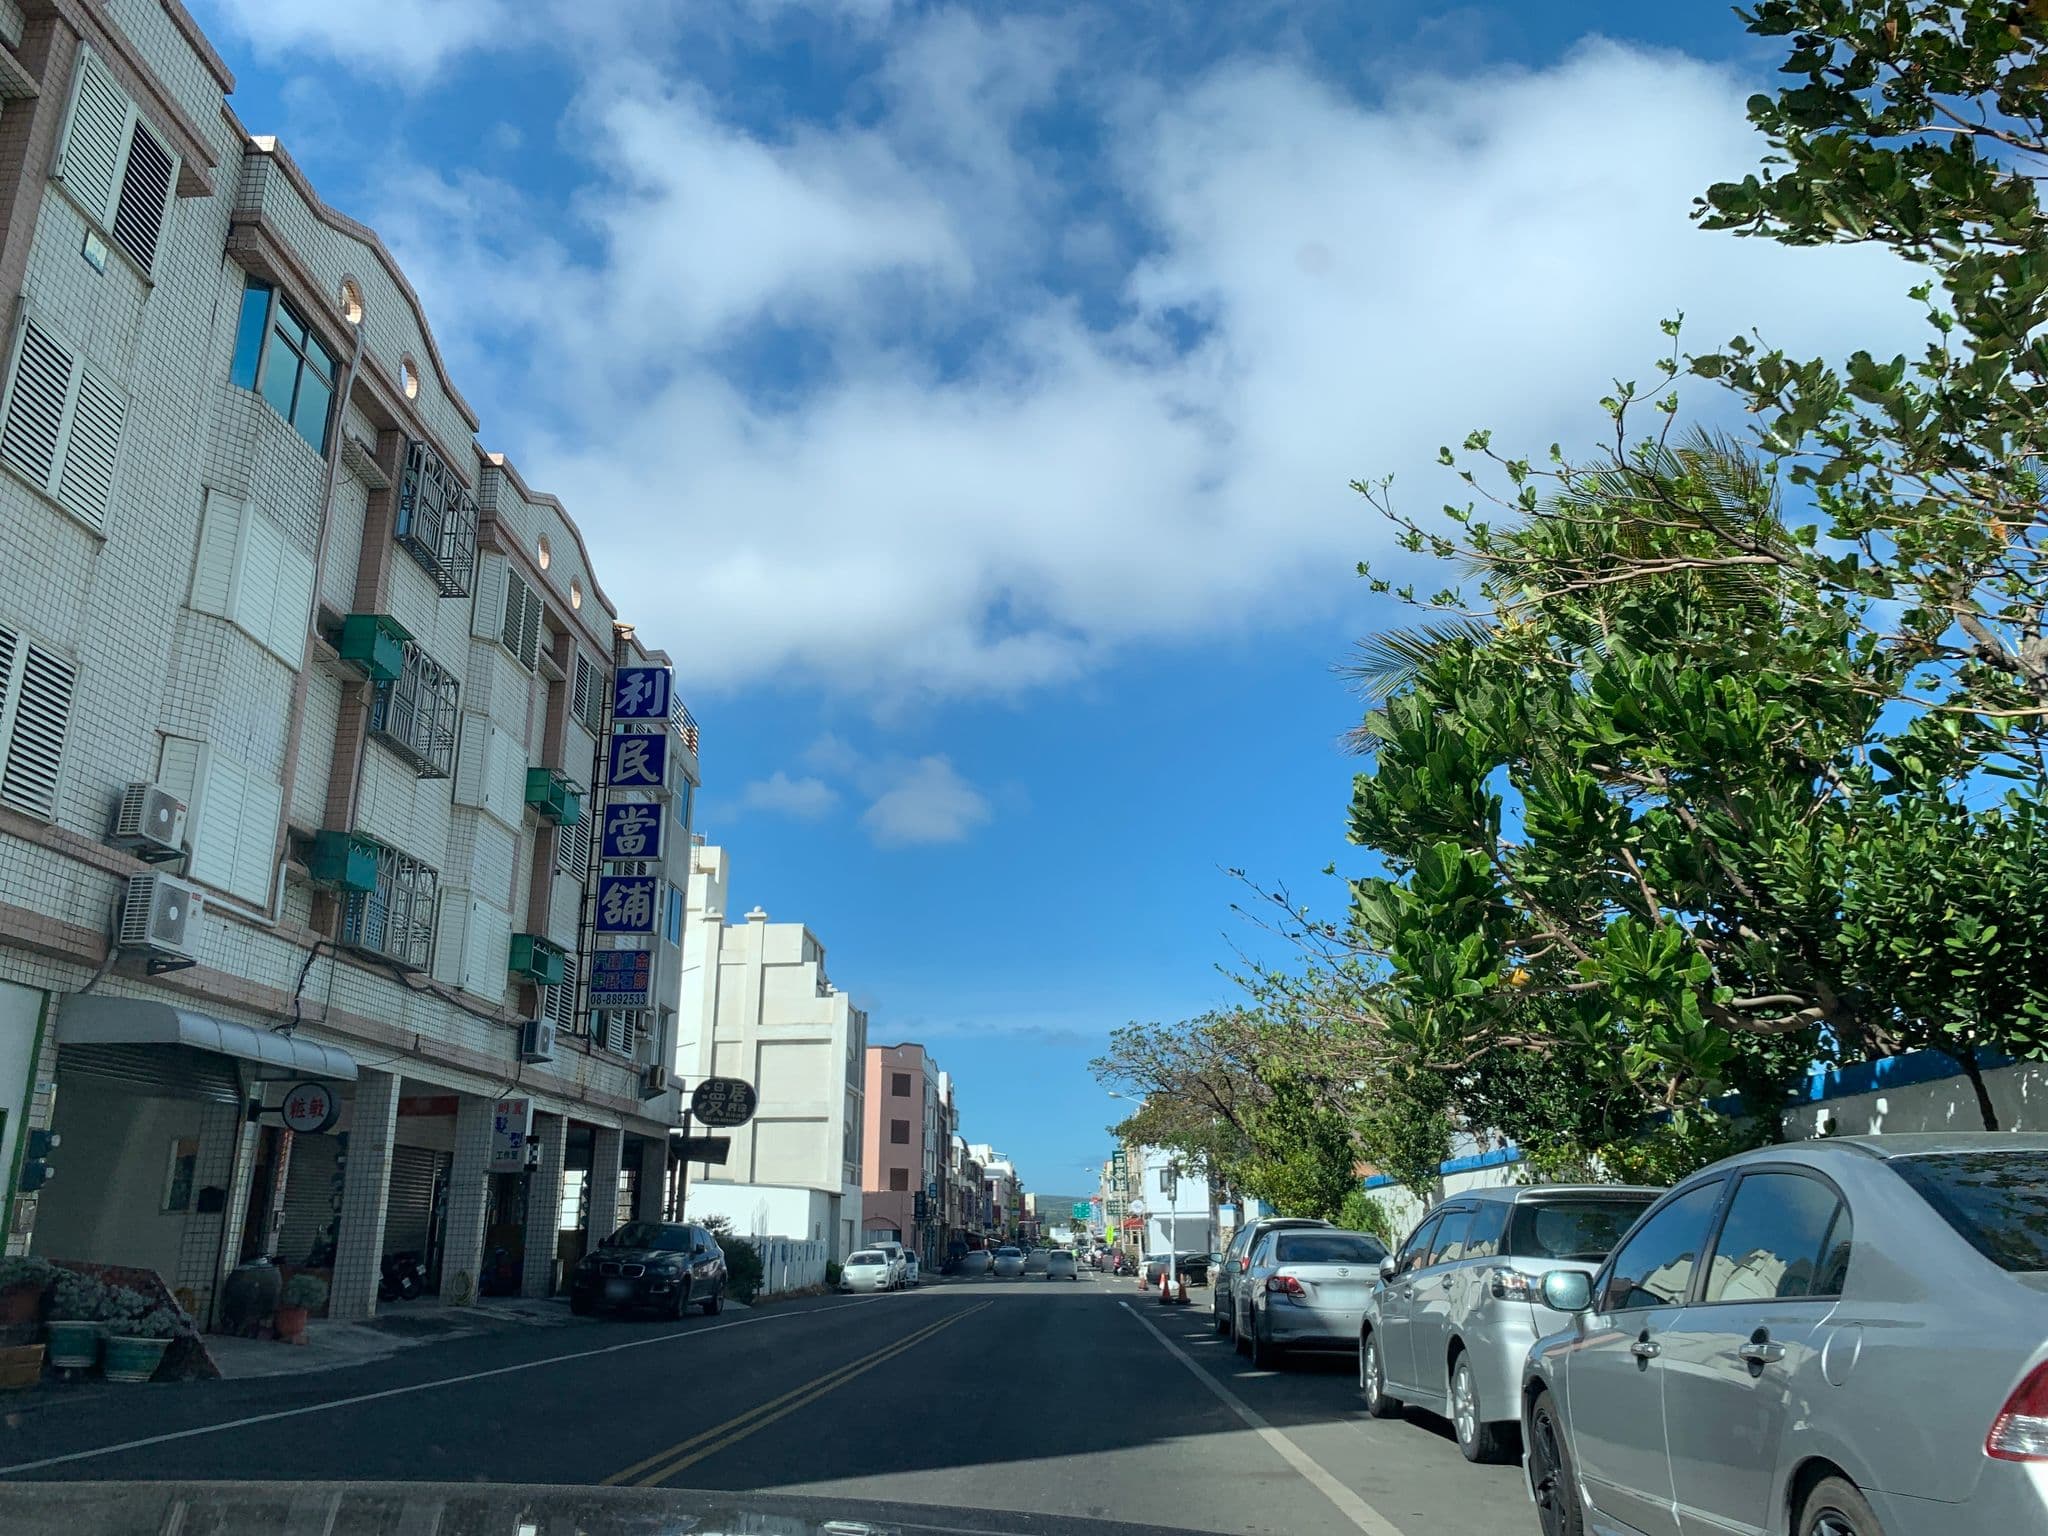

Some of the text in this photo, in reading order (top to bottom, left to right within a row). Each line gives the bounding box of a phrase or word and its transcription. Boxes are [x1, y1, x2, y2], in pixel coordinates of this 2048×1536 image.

[601, 670, 666, 928] 利民當舖
[590, 993, 646, 1005] 08-8892533
